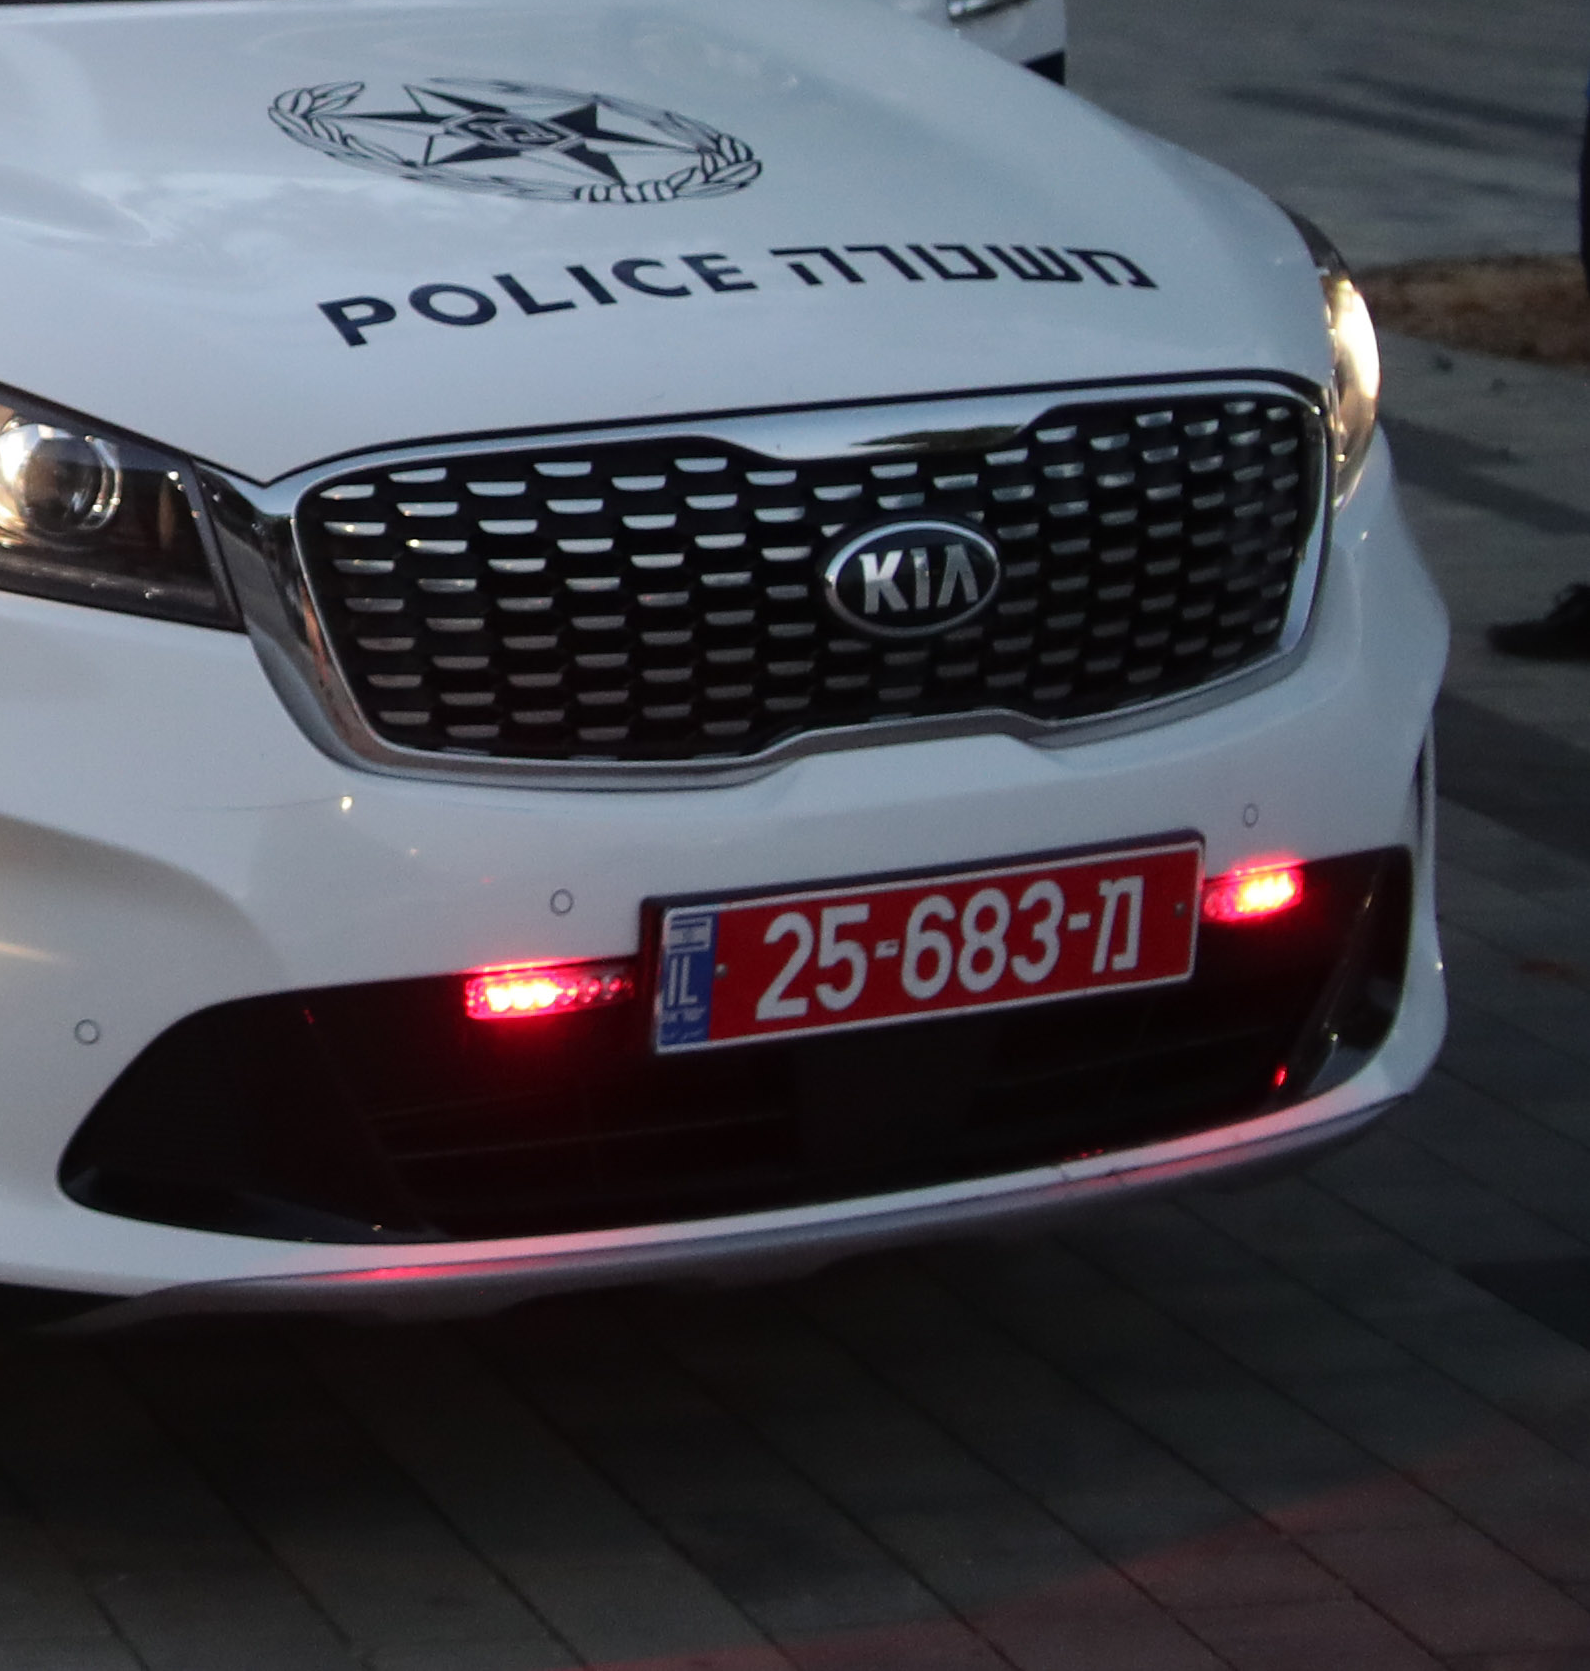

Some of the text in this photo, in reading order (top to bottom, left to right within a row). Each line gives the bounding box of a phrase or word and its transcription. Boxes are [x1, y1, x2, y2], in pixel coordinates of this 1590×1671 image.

[318, 242, 1160, 347] POLICE משטרה
[858, 543, 979, 615] KIA
[666, 955, 699, 1007] IL
